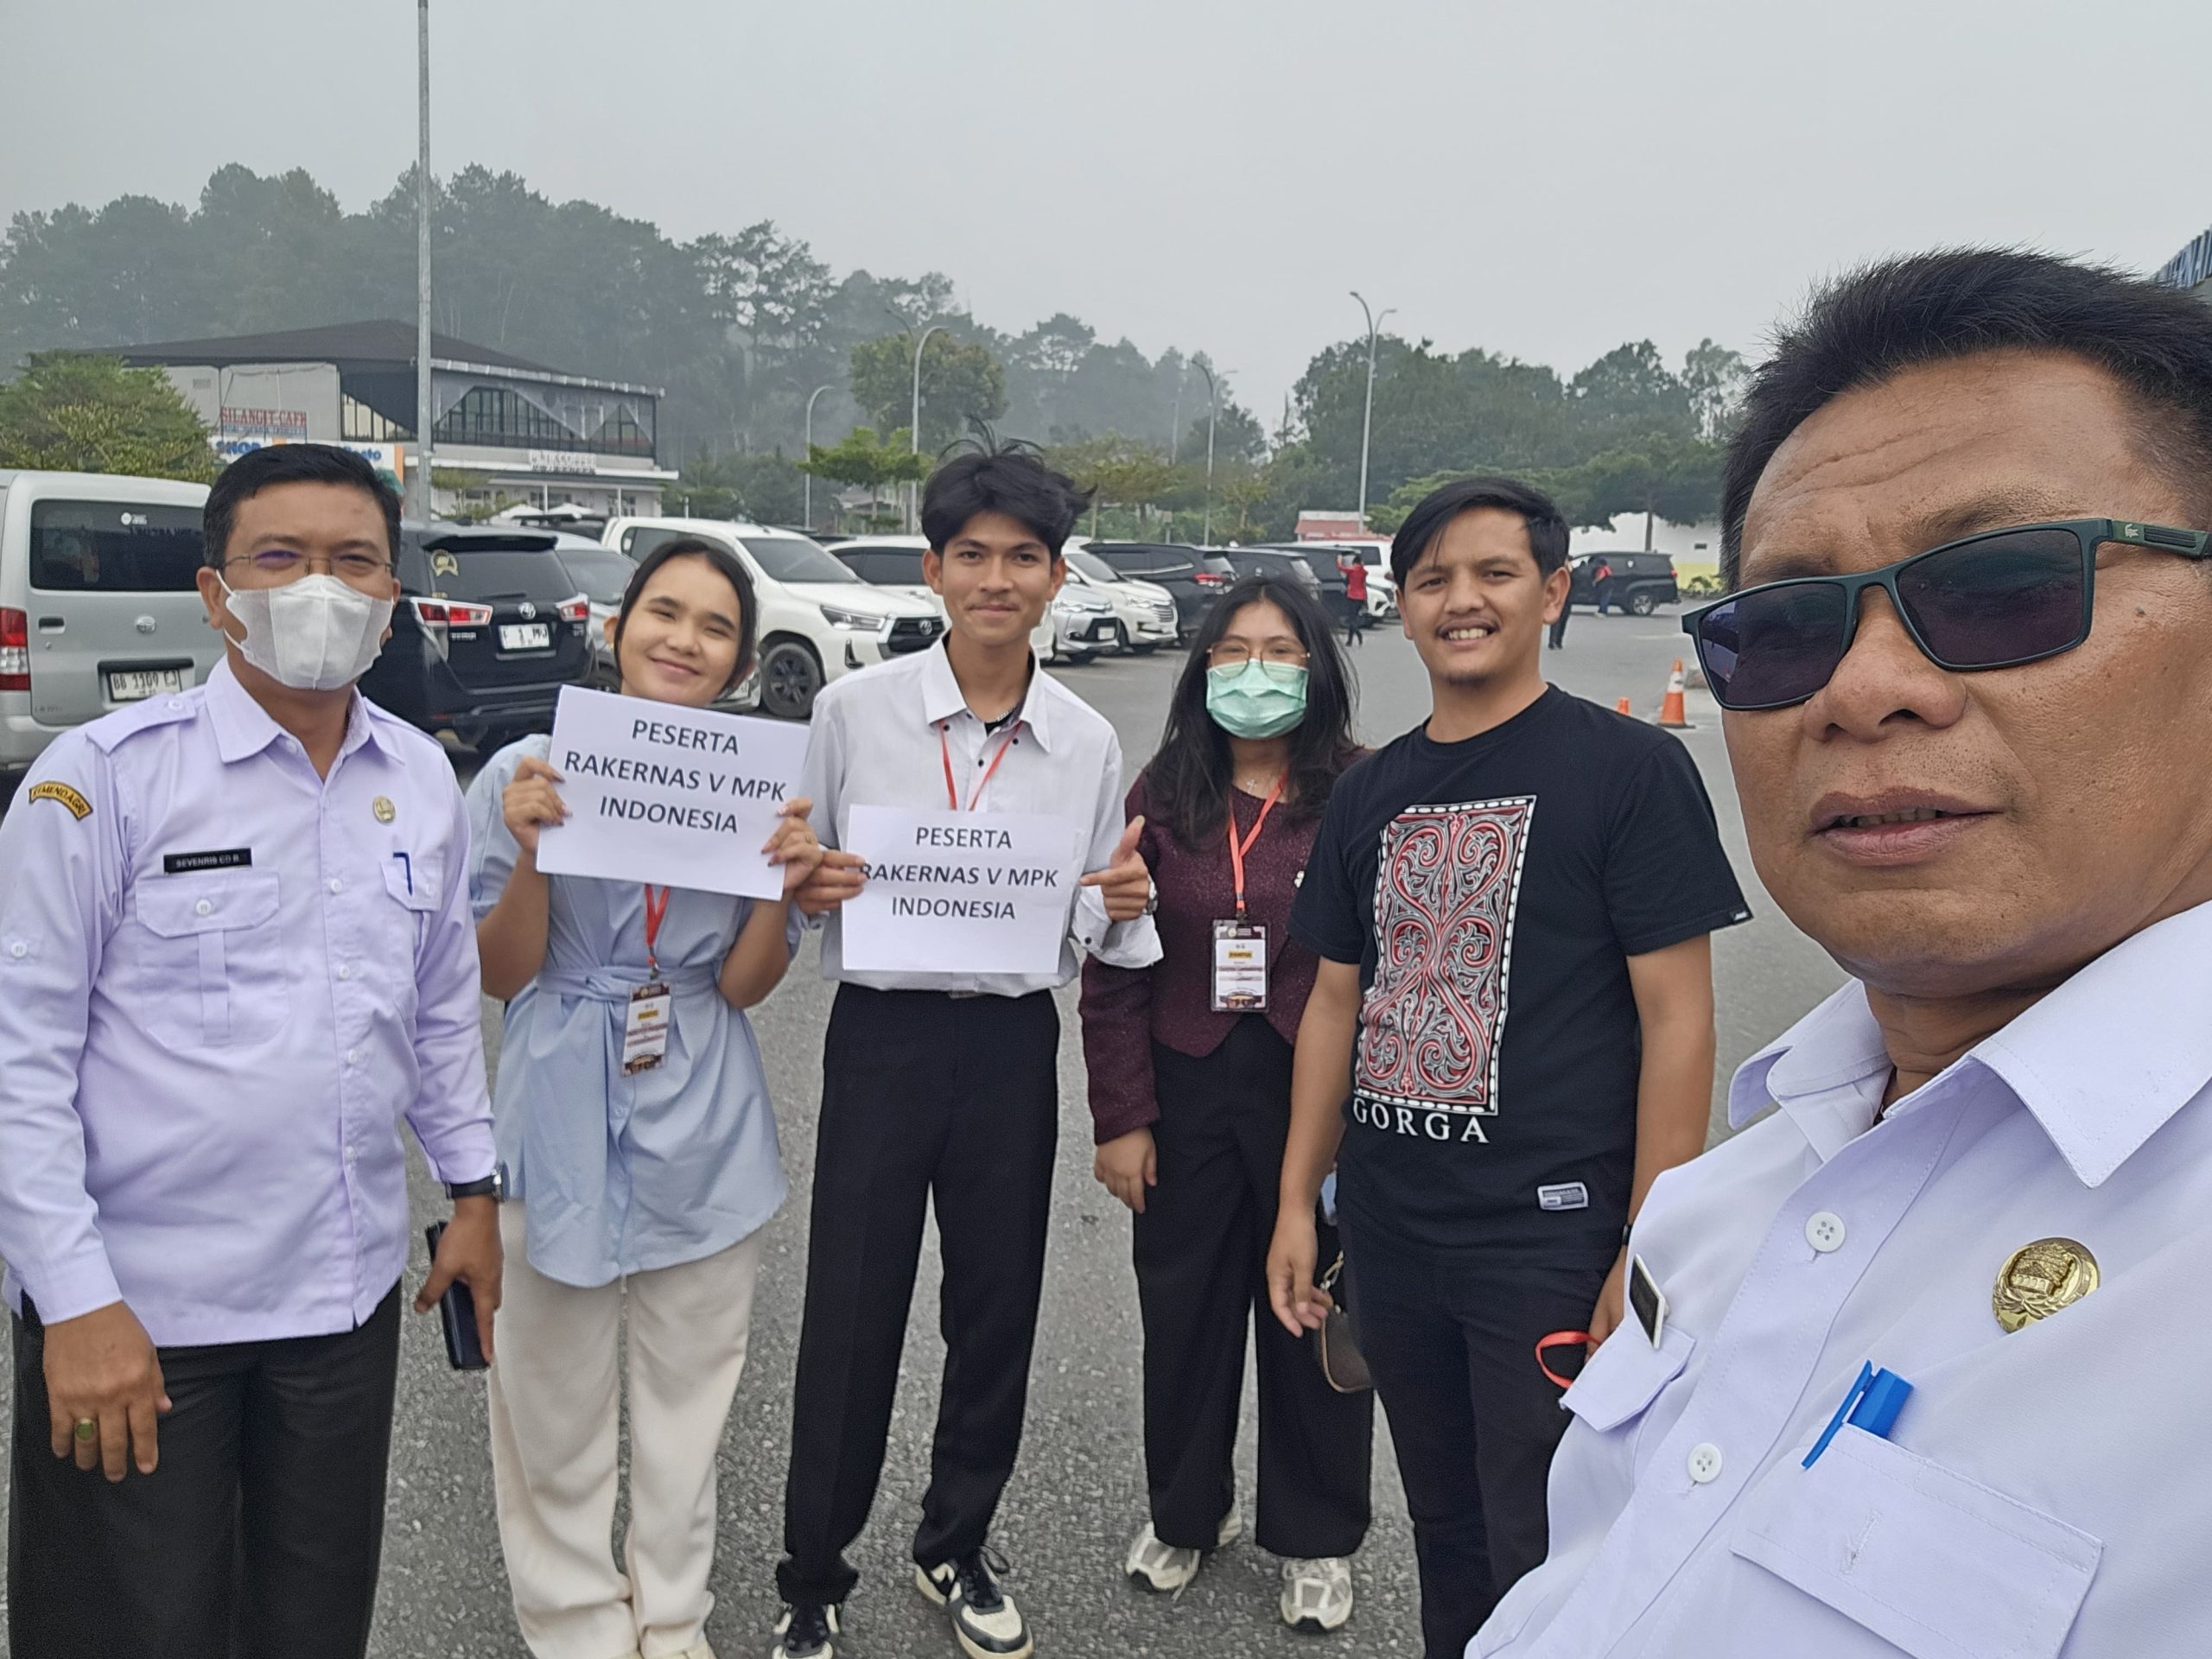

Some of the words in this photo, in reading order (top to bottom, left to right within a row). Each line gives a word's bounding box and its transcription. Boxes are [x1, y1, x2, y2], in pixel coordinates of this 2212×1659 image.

[632, 719, 739, 755] PESERTA
[564, 750, 701, 791] RAKERNAS
[709, 772, 726, 792] V
[732, 776, 786, 802] MPK
[600, 796, 738, 833] INDONESIA
[916, 827, 1012, 849] PESERTA
[860, 863, 980, 885] RAKERNAS
[987, 868, 1002, 885] V
[1007, 868, 1058, 887] MPK
[893, 896, 1015, 919] INDONESIA
[1353, 1097, 1490, 1143] GORGA
